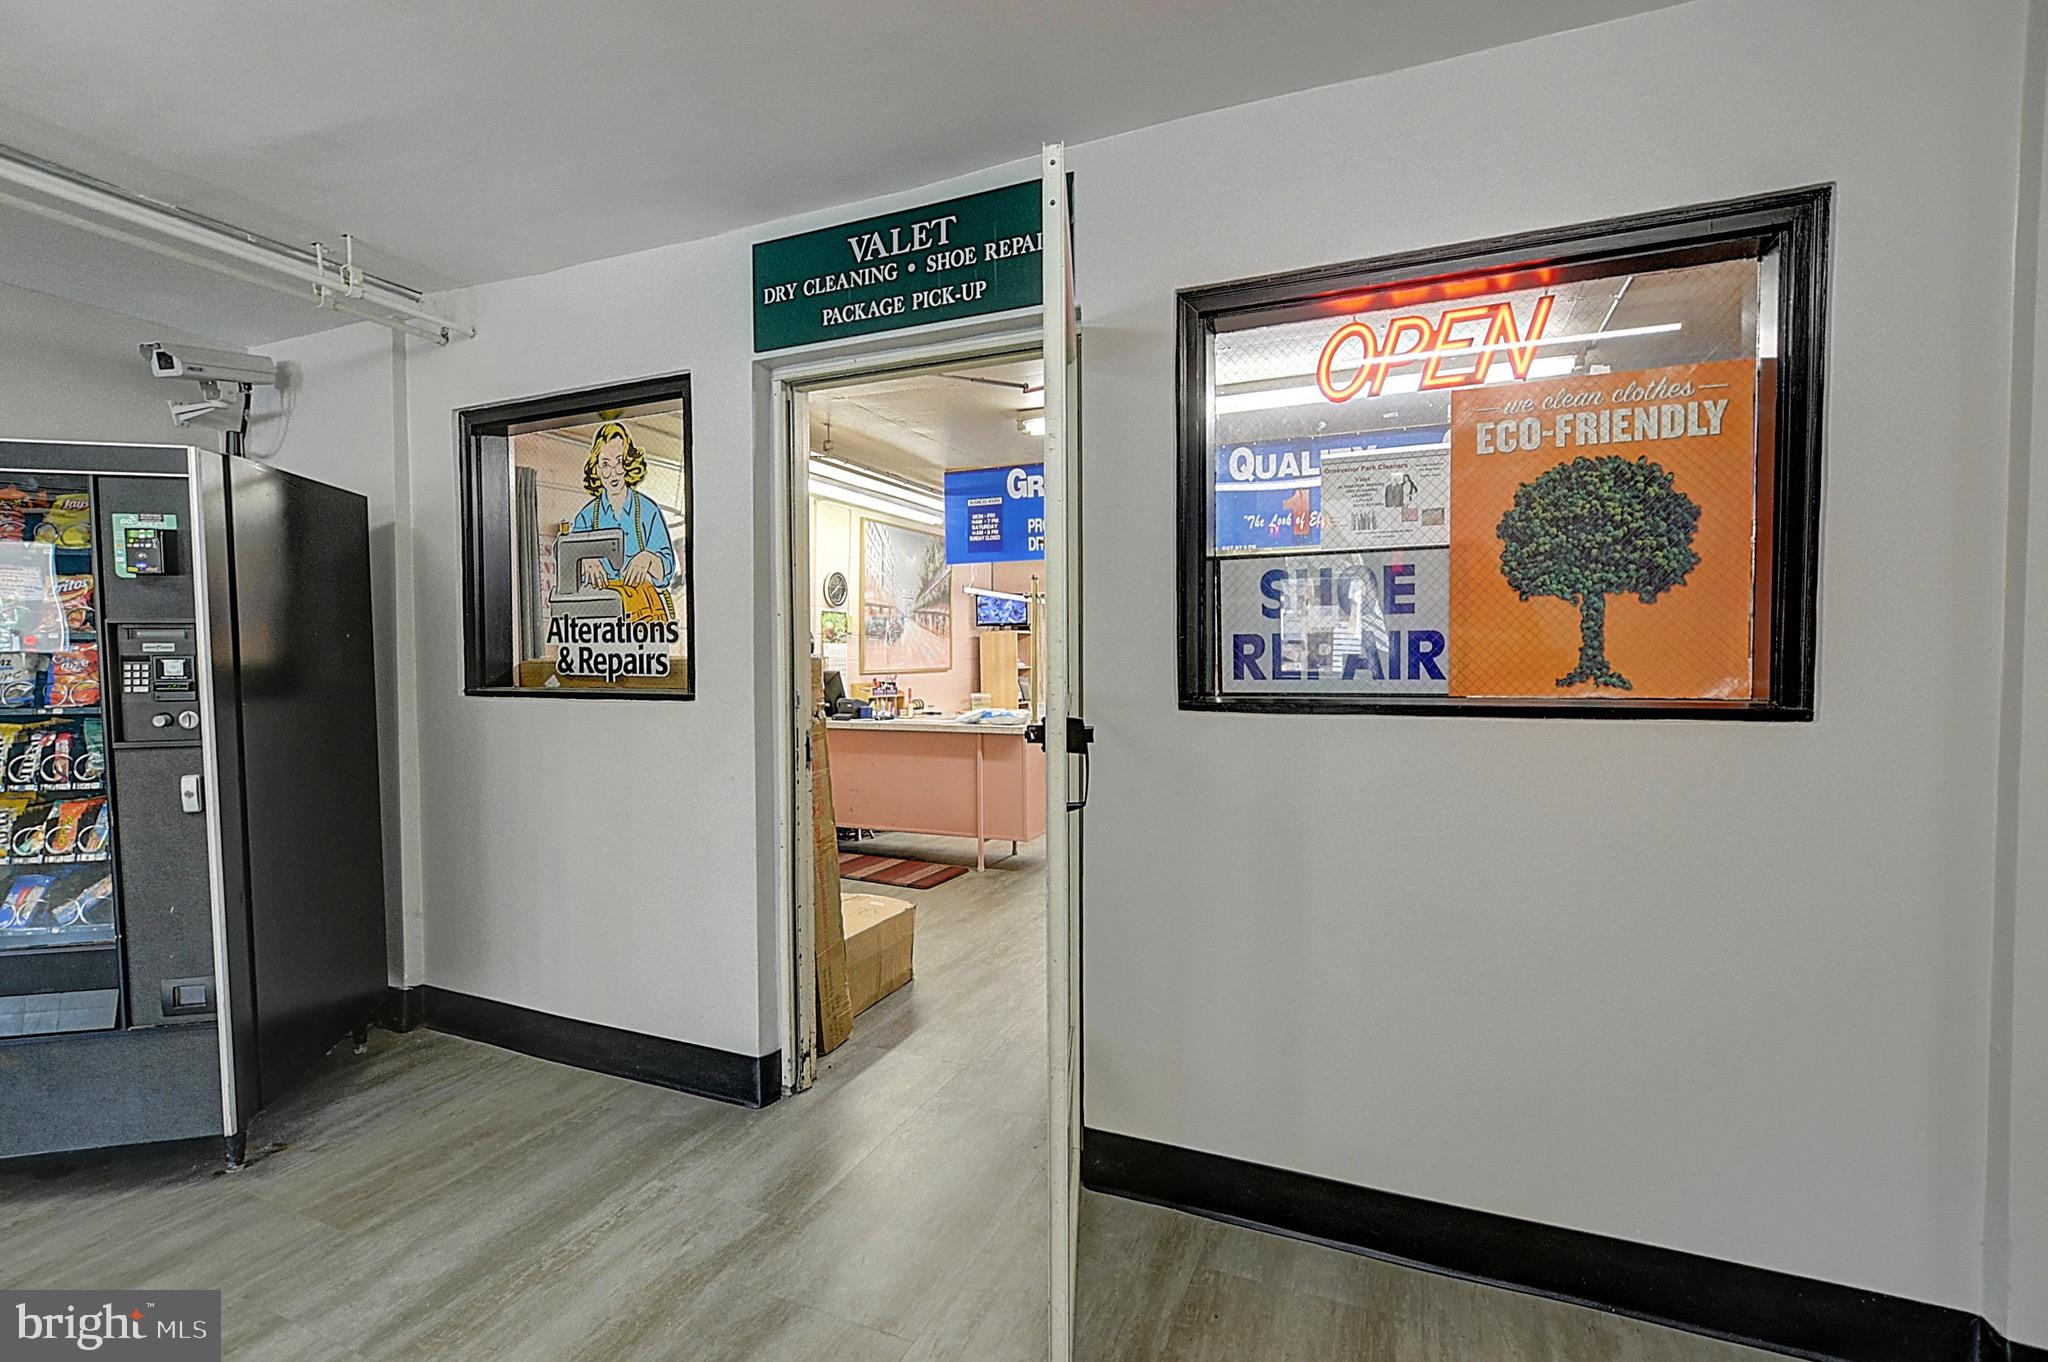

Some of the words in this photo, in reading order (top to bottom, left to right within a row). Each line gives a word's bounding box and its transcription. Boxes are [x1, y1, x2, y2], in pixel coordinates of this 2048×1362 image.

[848, 216, 957, 263] VALET
[763, 283, 797, 305] DRY
[803, 263, 898, 297] CLEANING
[926, 247, 977, 273] SHOE
[984, 232, 1043, 262] REPAI
[822, 296, 904, 326] PACKAGE
[912, 280, 987, 311] PICK-UP
[1316, 294, 1555, 403] OPEN
[1503, 400, 1534, 415] we
[1542, 388, 1604, 410] clean
[1612, 376, 1695, 404] clothes
[1476, 398, 1728, 455] ECO-FRIENDLY
[1229, 444, 1378, 482] QUAL
[1361, 464, 1376, 472] Park
[1007, 468, 1044, 499] GR
[547, 612, 679, 644] Alterations
[557, 646, 574, 673] &
[579, 644, 669, 683] Repairs
